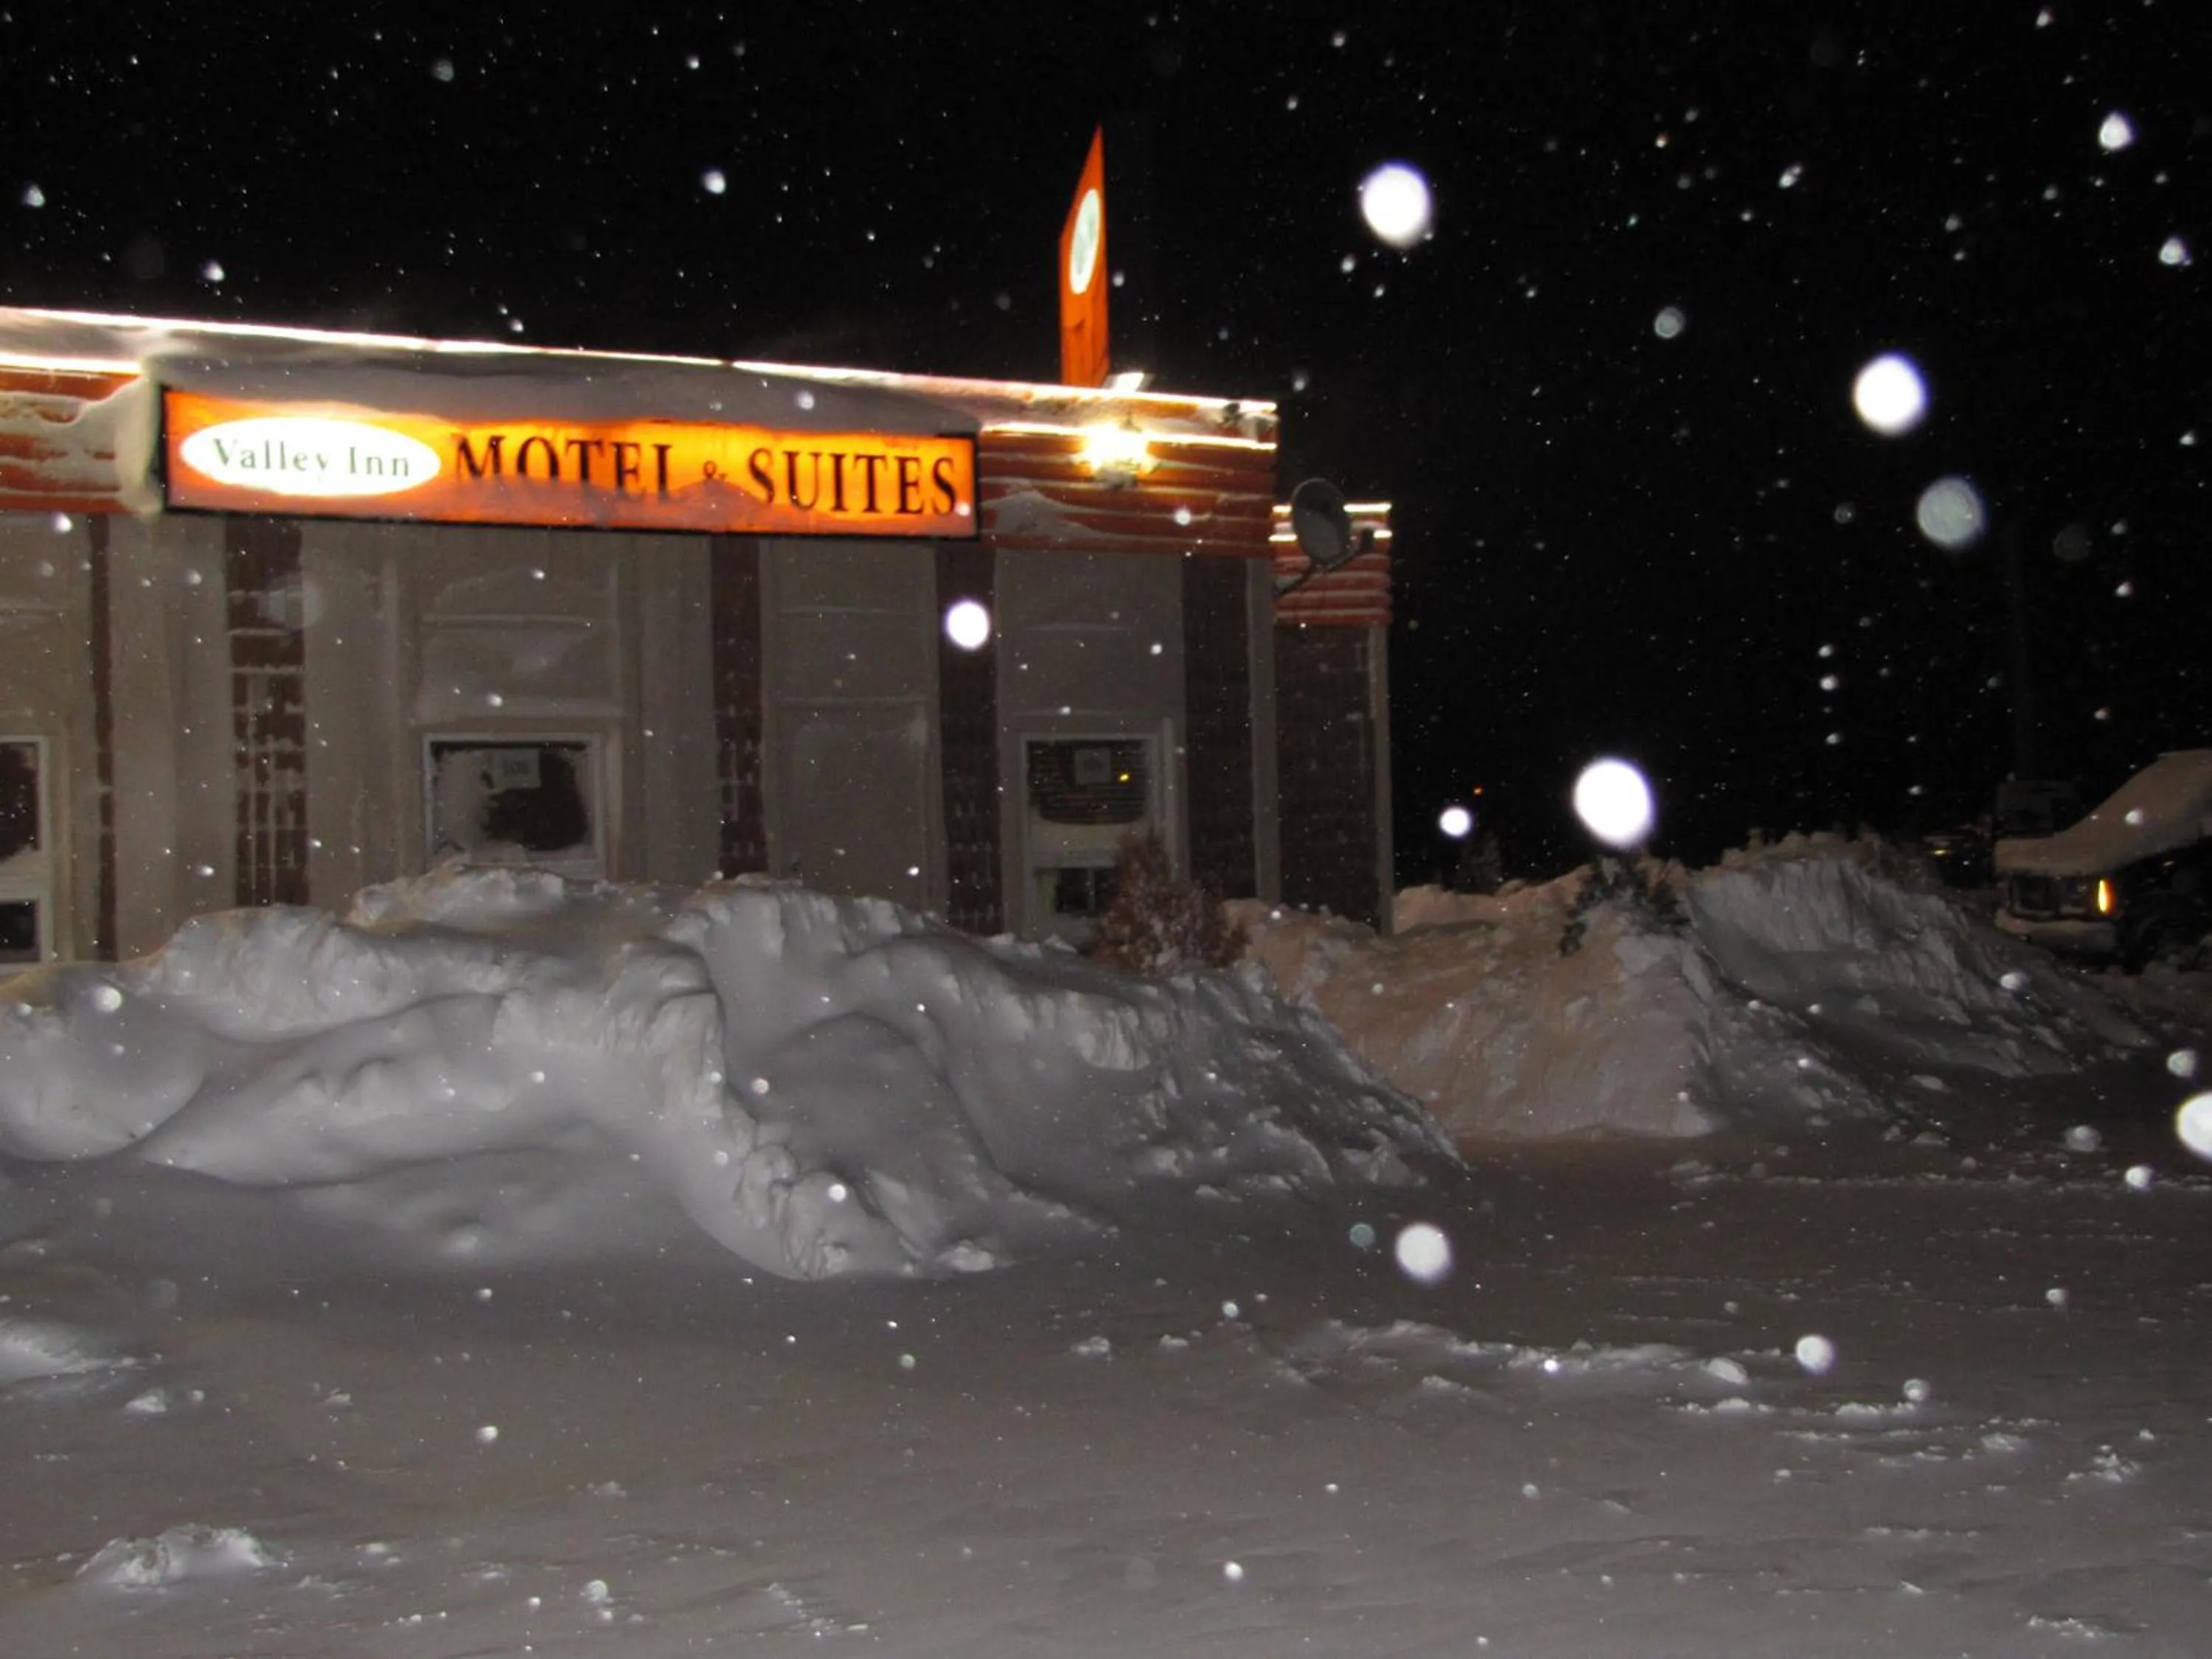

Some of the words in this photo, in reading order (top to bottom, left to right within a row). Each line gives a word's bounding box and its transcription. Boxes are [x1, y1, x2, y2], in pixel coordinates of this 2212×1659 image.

[213, 438, 330, 481] Valley
[349, 446, 409, 476] Inn
[748, 448, 956, 515] SUITES
